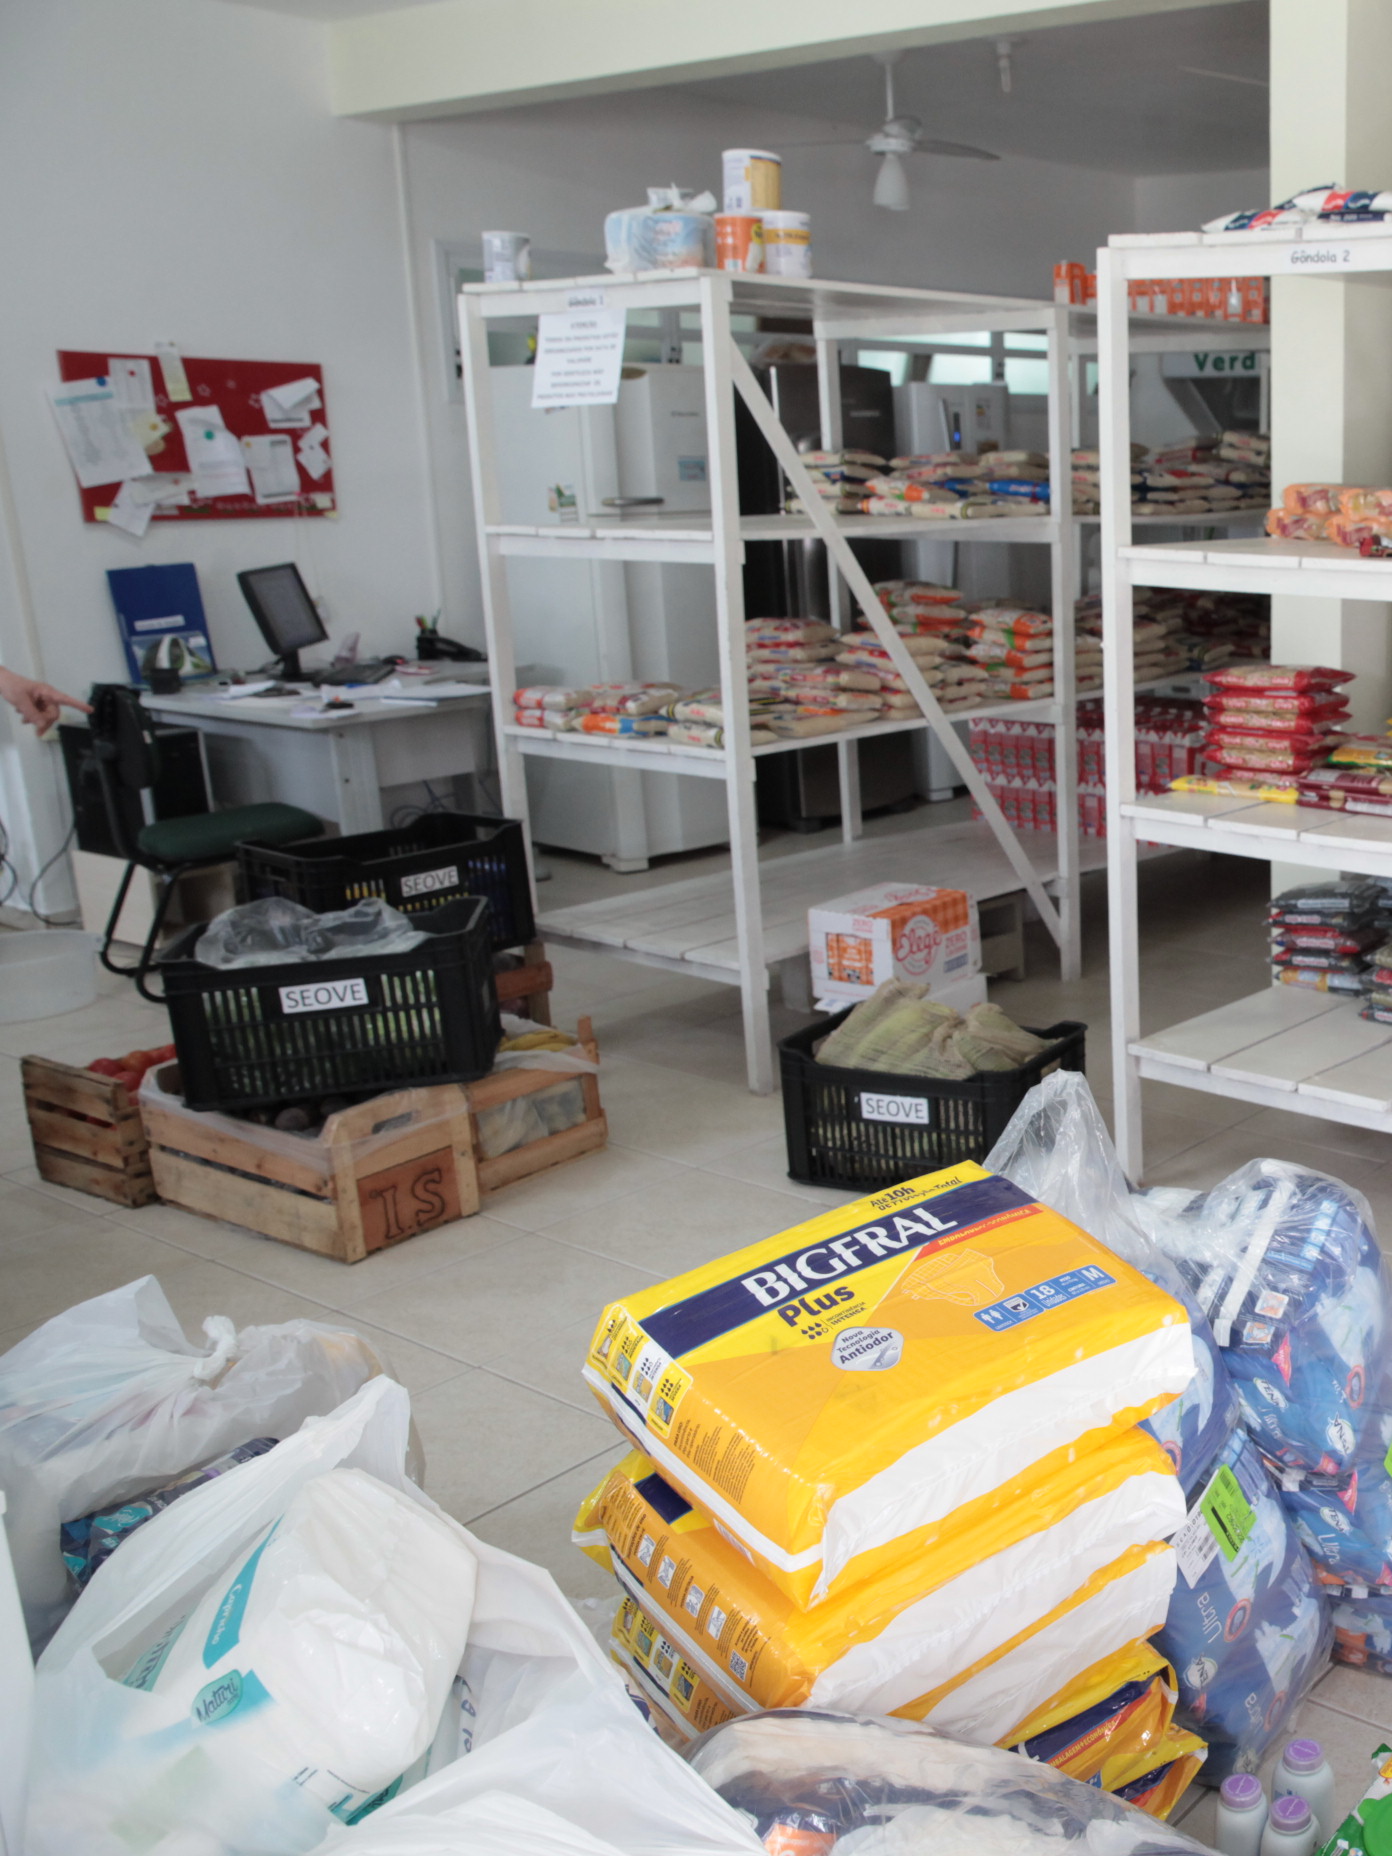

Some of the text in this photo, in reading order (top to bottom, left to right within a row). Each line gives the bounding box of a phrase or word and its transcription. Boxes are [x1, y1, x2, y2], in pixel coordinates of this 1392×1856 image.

[1291, 250, 1350, 264] Gôndola 2
[402, 869, 457, 896] SEOVE
[285, 982, 364, 1010] SEOVE
[866, 1097, 925, 1121] SEOVE
[885, 1186, 916, 1201] 10h
[741, 1208, 958, 1307] BIGFRAL
[1081, 1267, 1104, 1281] M
[1030, 1285, 1056, 1300] 18
[777, 1286, 855, 1328] Plus
[831, 1308, 867, 1326] INTENSA
[838, 1329, 881, 1354] Tecnologia
[839, 1331, 894, 1364] Antiodor
[841, 1329, 864, 1343] Nova
